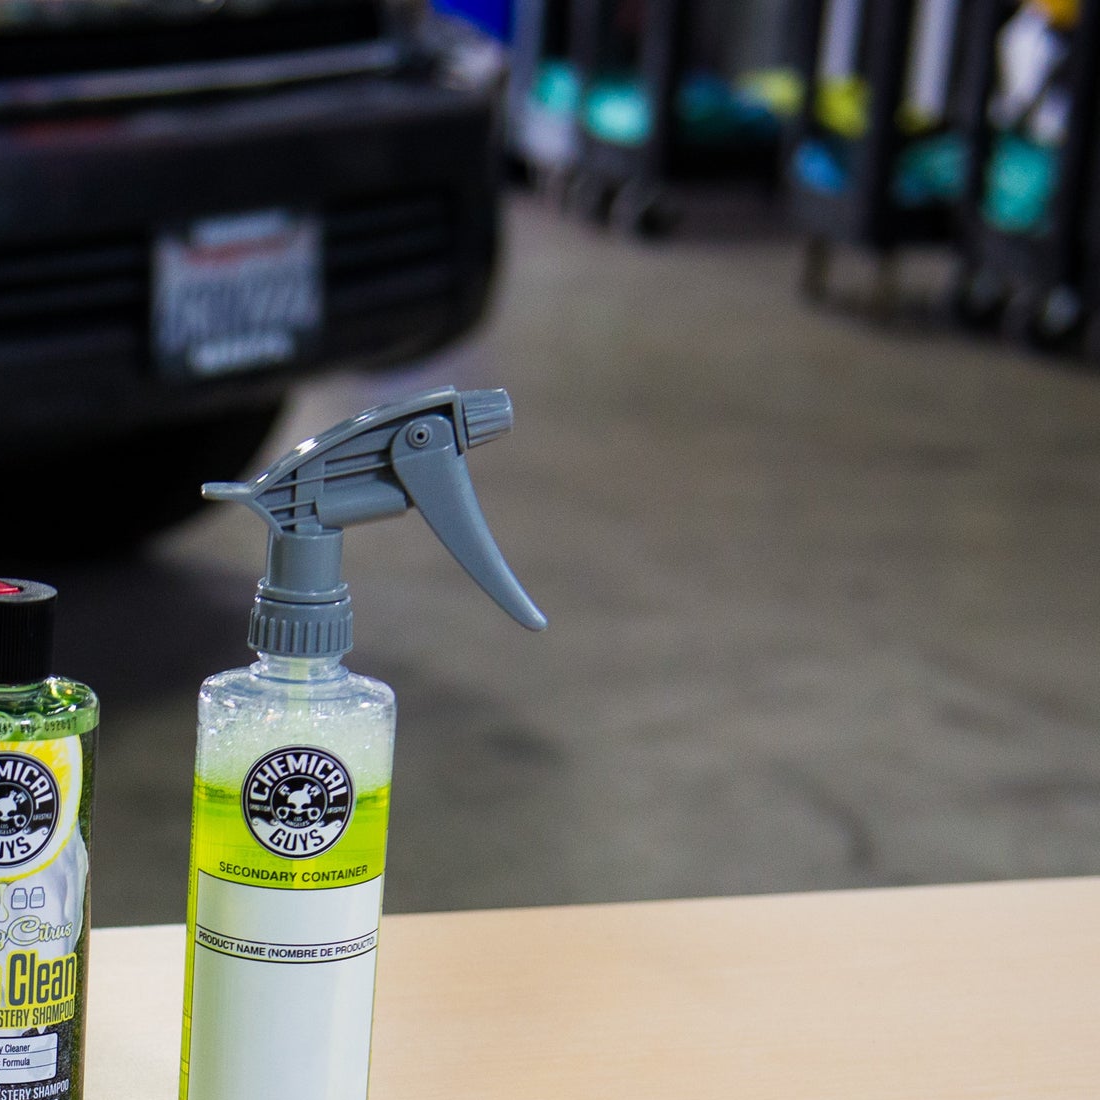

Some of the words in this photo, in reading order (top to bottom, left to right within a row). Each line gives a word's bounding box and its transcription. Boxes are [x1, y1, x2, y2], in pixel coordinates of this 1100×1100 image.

[250, 753, 349, 803] CHEMICAL
[268, 828, 325, 851] GUYS
[219, 861, 298, 882] SECONDARY
[301, 864, 368, 882] CONTAINER
[8, 914, 73, 946] Citrus
[198, 930, 235, 950] PRODUCT
[236, 943, 266, 956] NAME
[267, 948, 318, 959] (NOMBRE
[320, 947, 333, 957] DE
[8, 952, 76, 1006] Clean
[32, 998, 75, 1026] SHAMPOO
[5, 1043, 30, 1053] Cleaner
[2, 1057, 30, 1067] Formula
[33, 1078, 70, 1099] SHAMPOO
